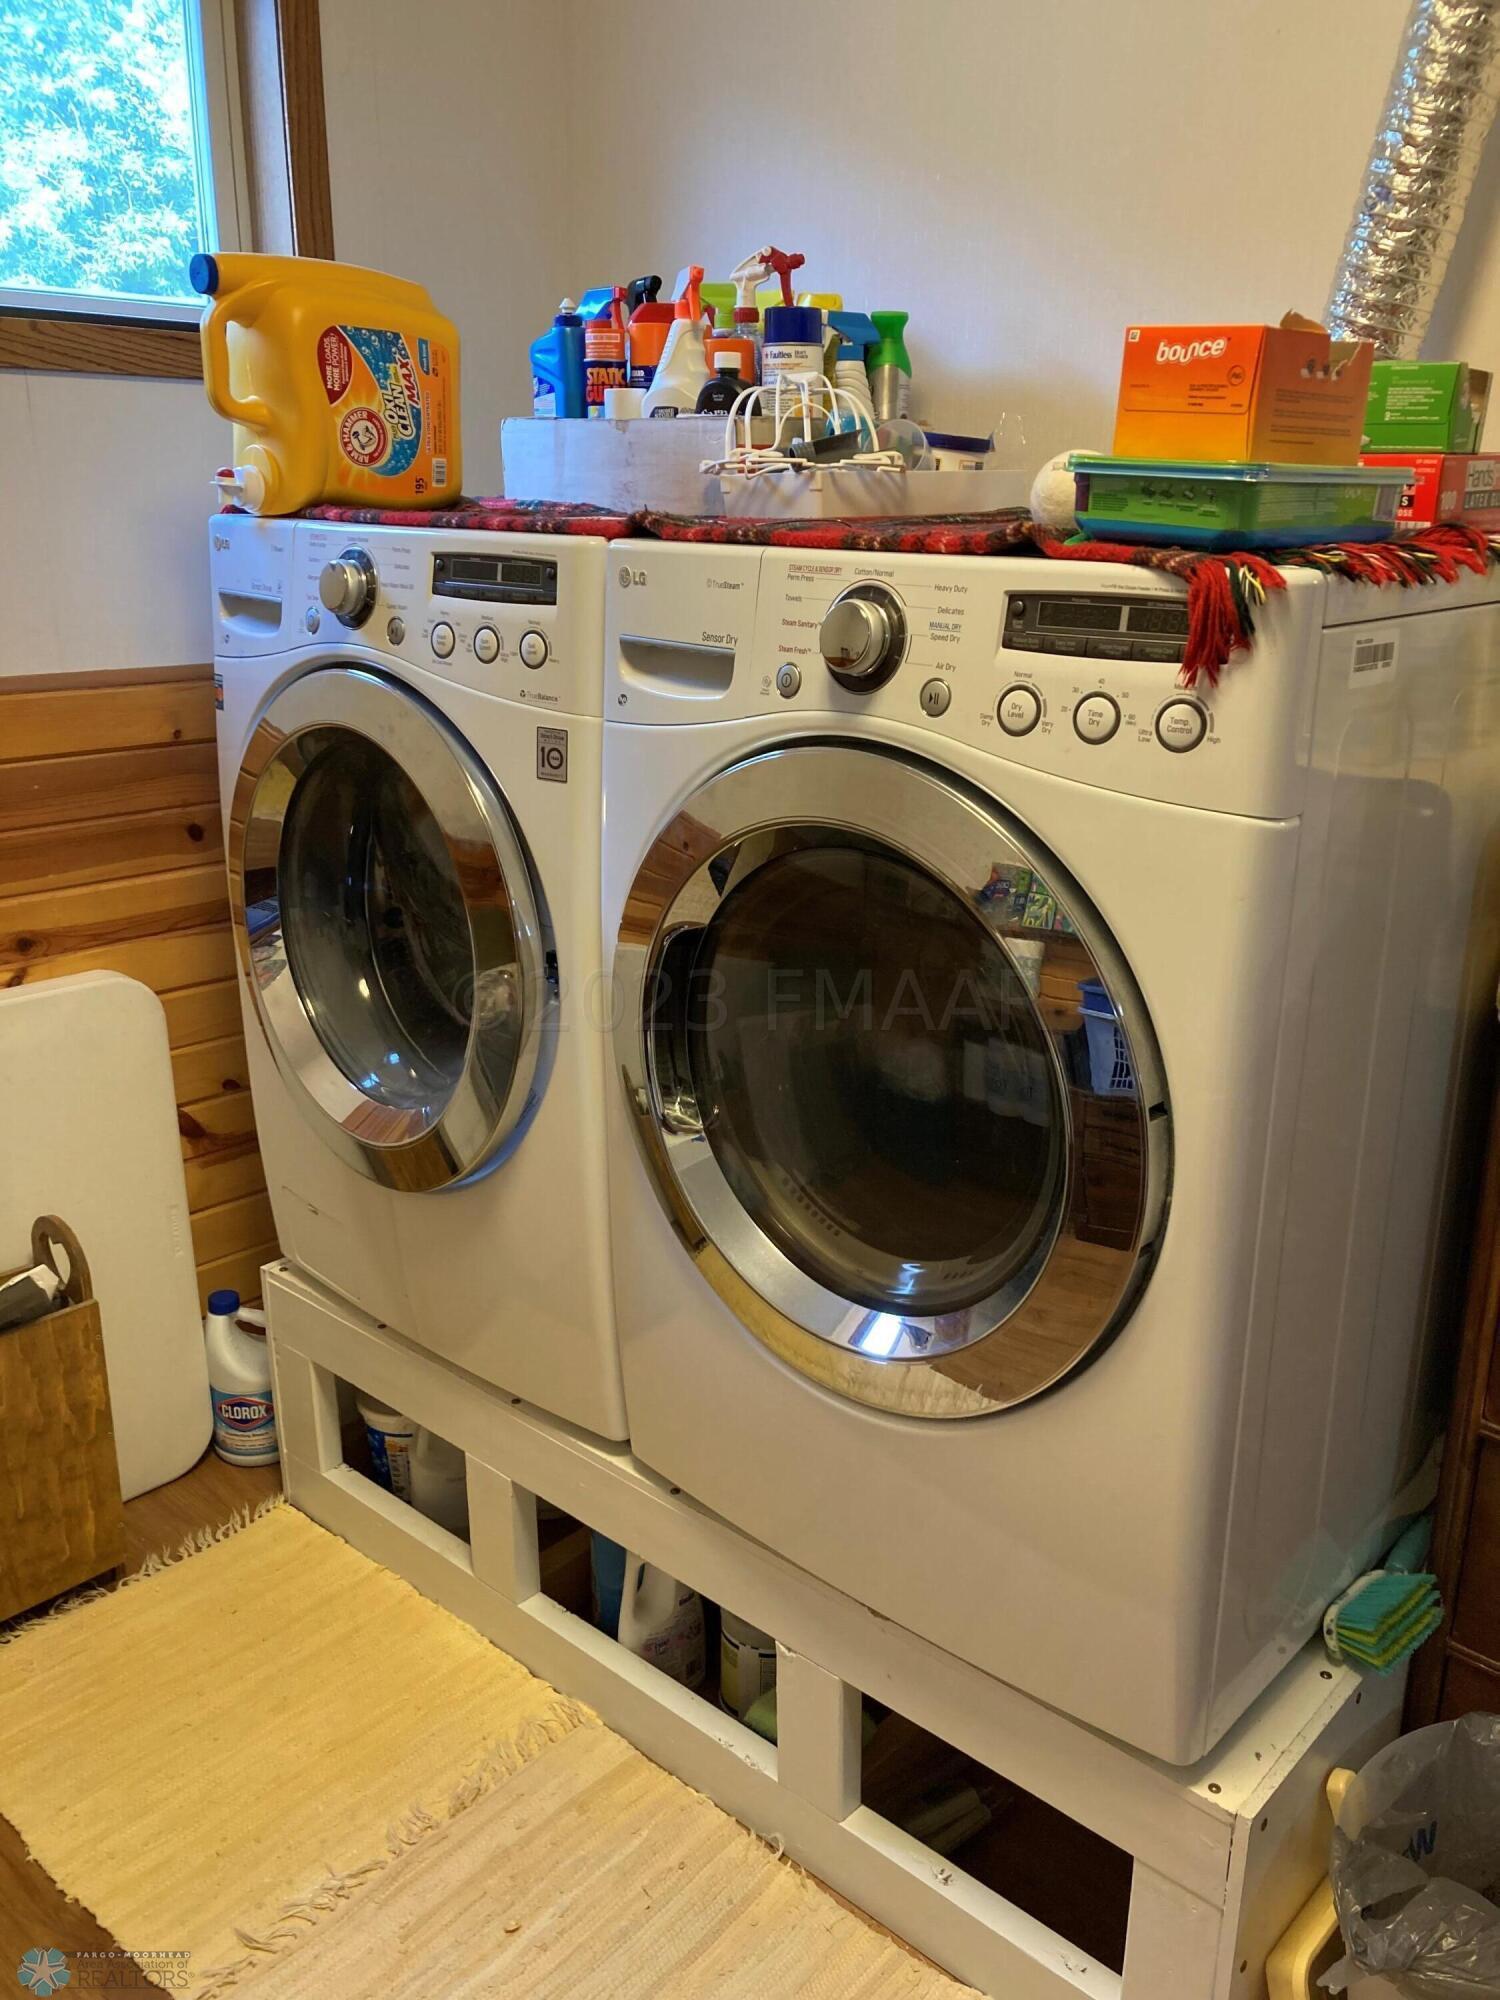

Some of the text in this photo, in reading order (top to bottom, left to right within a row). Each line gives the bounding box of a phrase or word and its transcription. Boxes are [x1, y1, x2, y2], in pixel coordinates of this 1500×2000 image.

[769, 350, 792, 359] Faultless
[1156, 337, 1227, 364] bounce
[325, 365, 333, 389] MORE
[333, 367, 341, 391] MORE
[397, 357, 419, 406] MAX
[383, 393, 399, 424] OXI
[390, 383, 412, 437] CLEAN
[342, 410, 368, 442] HAMMER
[350, 450, 369, 463] ARM
[415, 478, 424, 494] 195
[1401, 496, 1408, 506] S
[632, 570, 647, 586] LG
[787, 573, 814, 582] Perm Press
[934, 584, 968, 594] Heavy Duty
[785, 593, 802, 602] Towels
[937, 606, 965, 616] Delicates
[781, 618, 797, 626] Steam
[929, 621, 961, 631] MANUAL DRY
[702, 631, 738, 645] Sensor Dry
[930, 633, 961, 644] Speed Dry
[778, 645, 793, 653] Steam
[935, 661, 957, 673] Air Dry
[1014, 671, 1032, 679] Normal
[1011, 703, 1022, 712] Dry
[1007, 709, 1024, 719] Level
[1087, 709, 1104, 719] Time
[981, 719, 991, 727] Dry
[1042, 720, 1054, 728] Very
[1088, 717, 1100, 727] Dry
[1170, 717, 1190, 728] Temp.
[1041, 726, 1051, 735] Dry
[1138, 728, 1152, 737] Ultra
[1166, 725, 1193, 735] Control
[1207, 736, 1221, 745] High
[540, 745, 564, 770] 10
[221, 1404, 267, 1419] CLOROX
